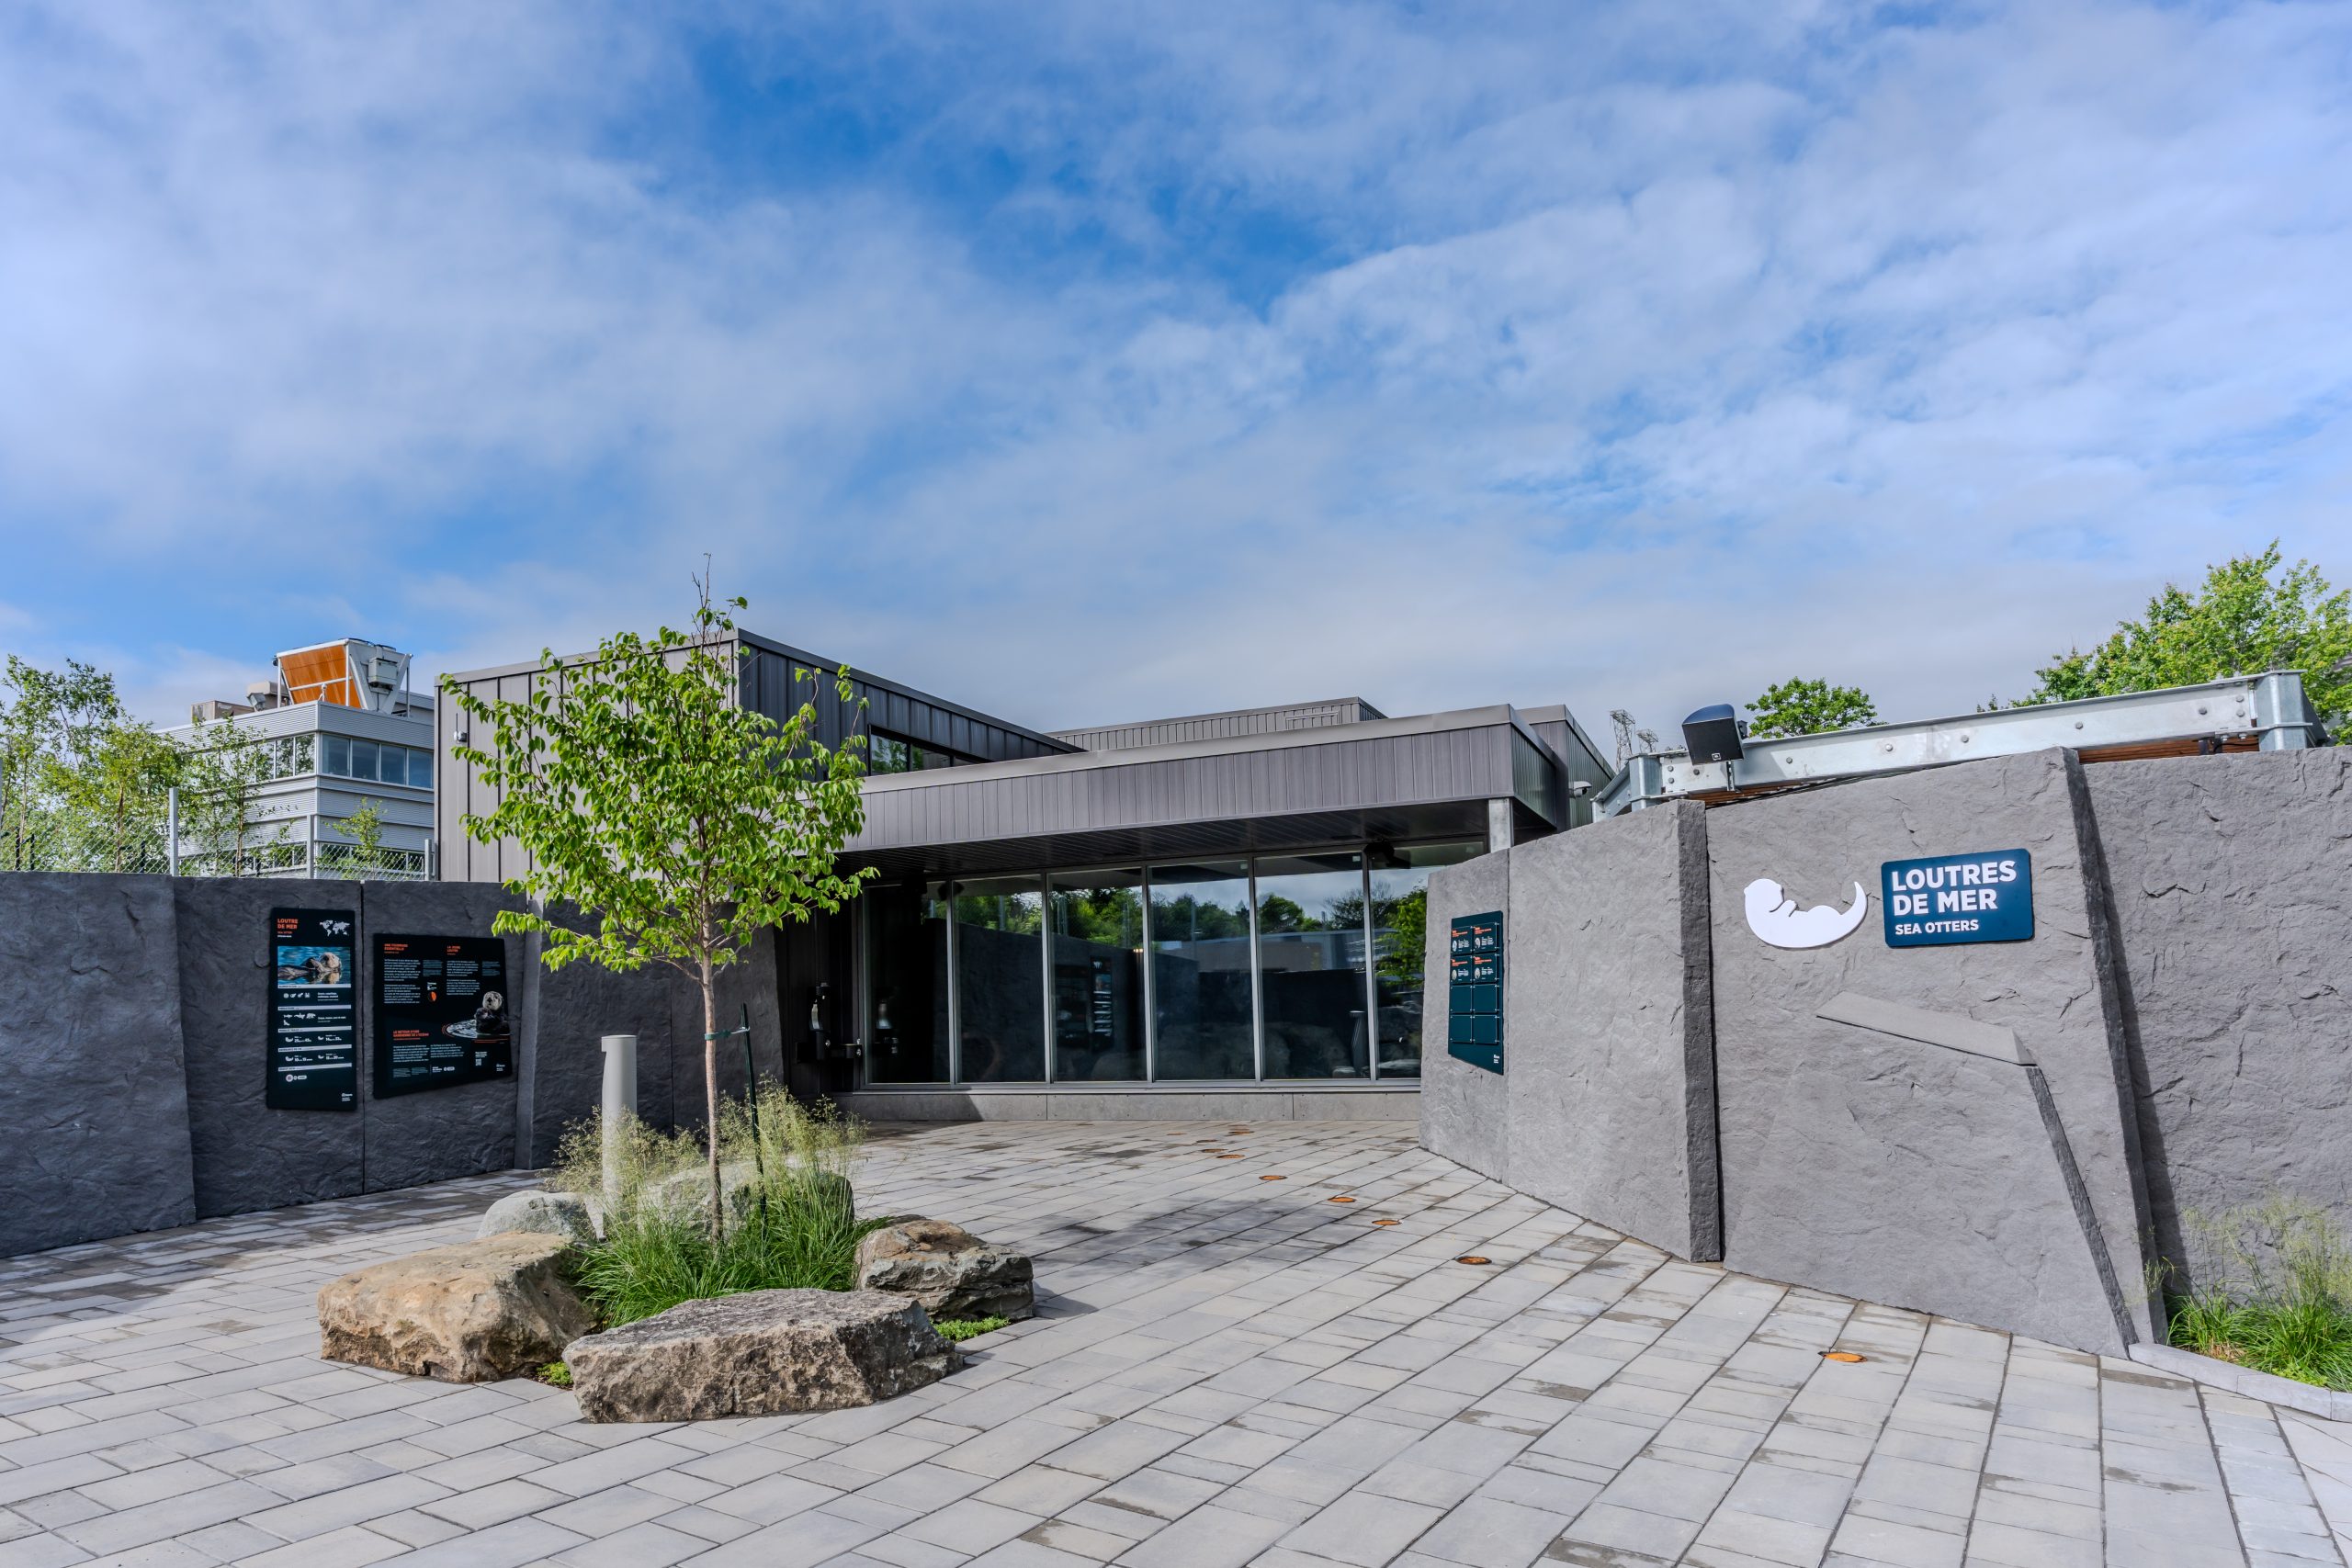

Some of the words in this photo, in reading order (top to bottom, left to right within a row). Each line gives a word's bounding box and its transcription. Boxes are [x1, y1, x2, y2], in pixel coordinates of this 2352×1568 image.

[1892, 860, 2017, 891] LOUTRES
[1894, 893, 1928, 916] DE
[1938, 888, 1997, 913] MER
[1895, 922, 1922, 935] SEA
[1925, 919, 1979, 933] OTTERS
